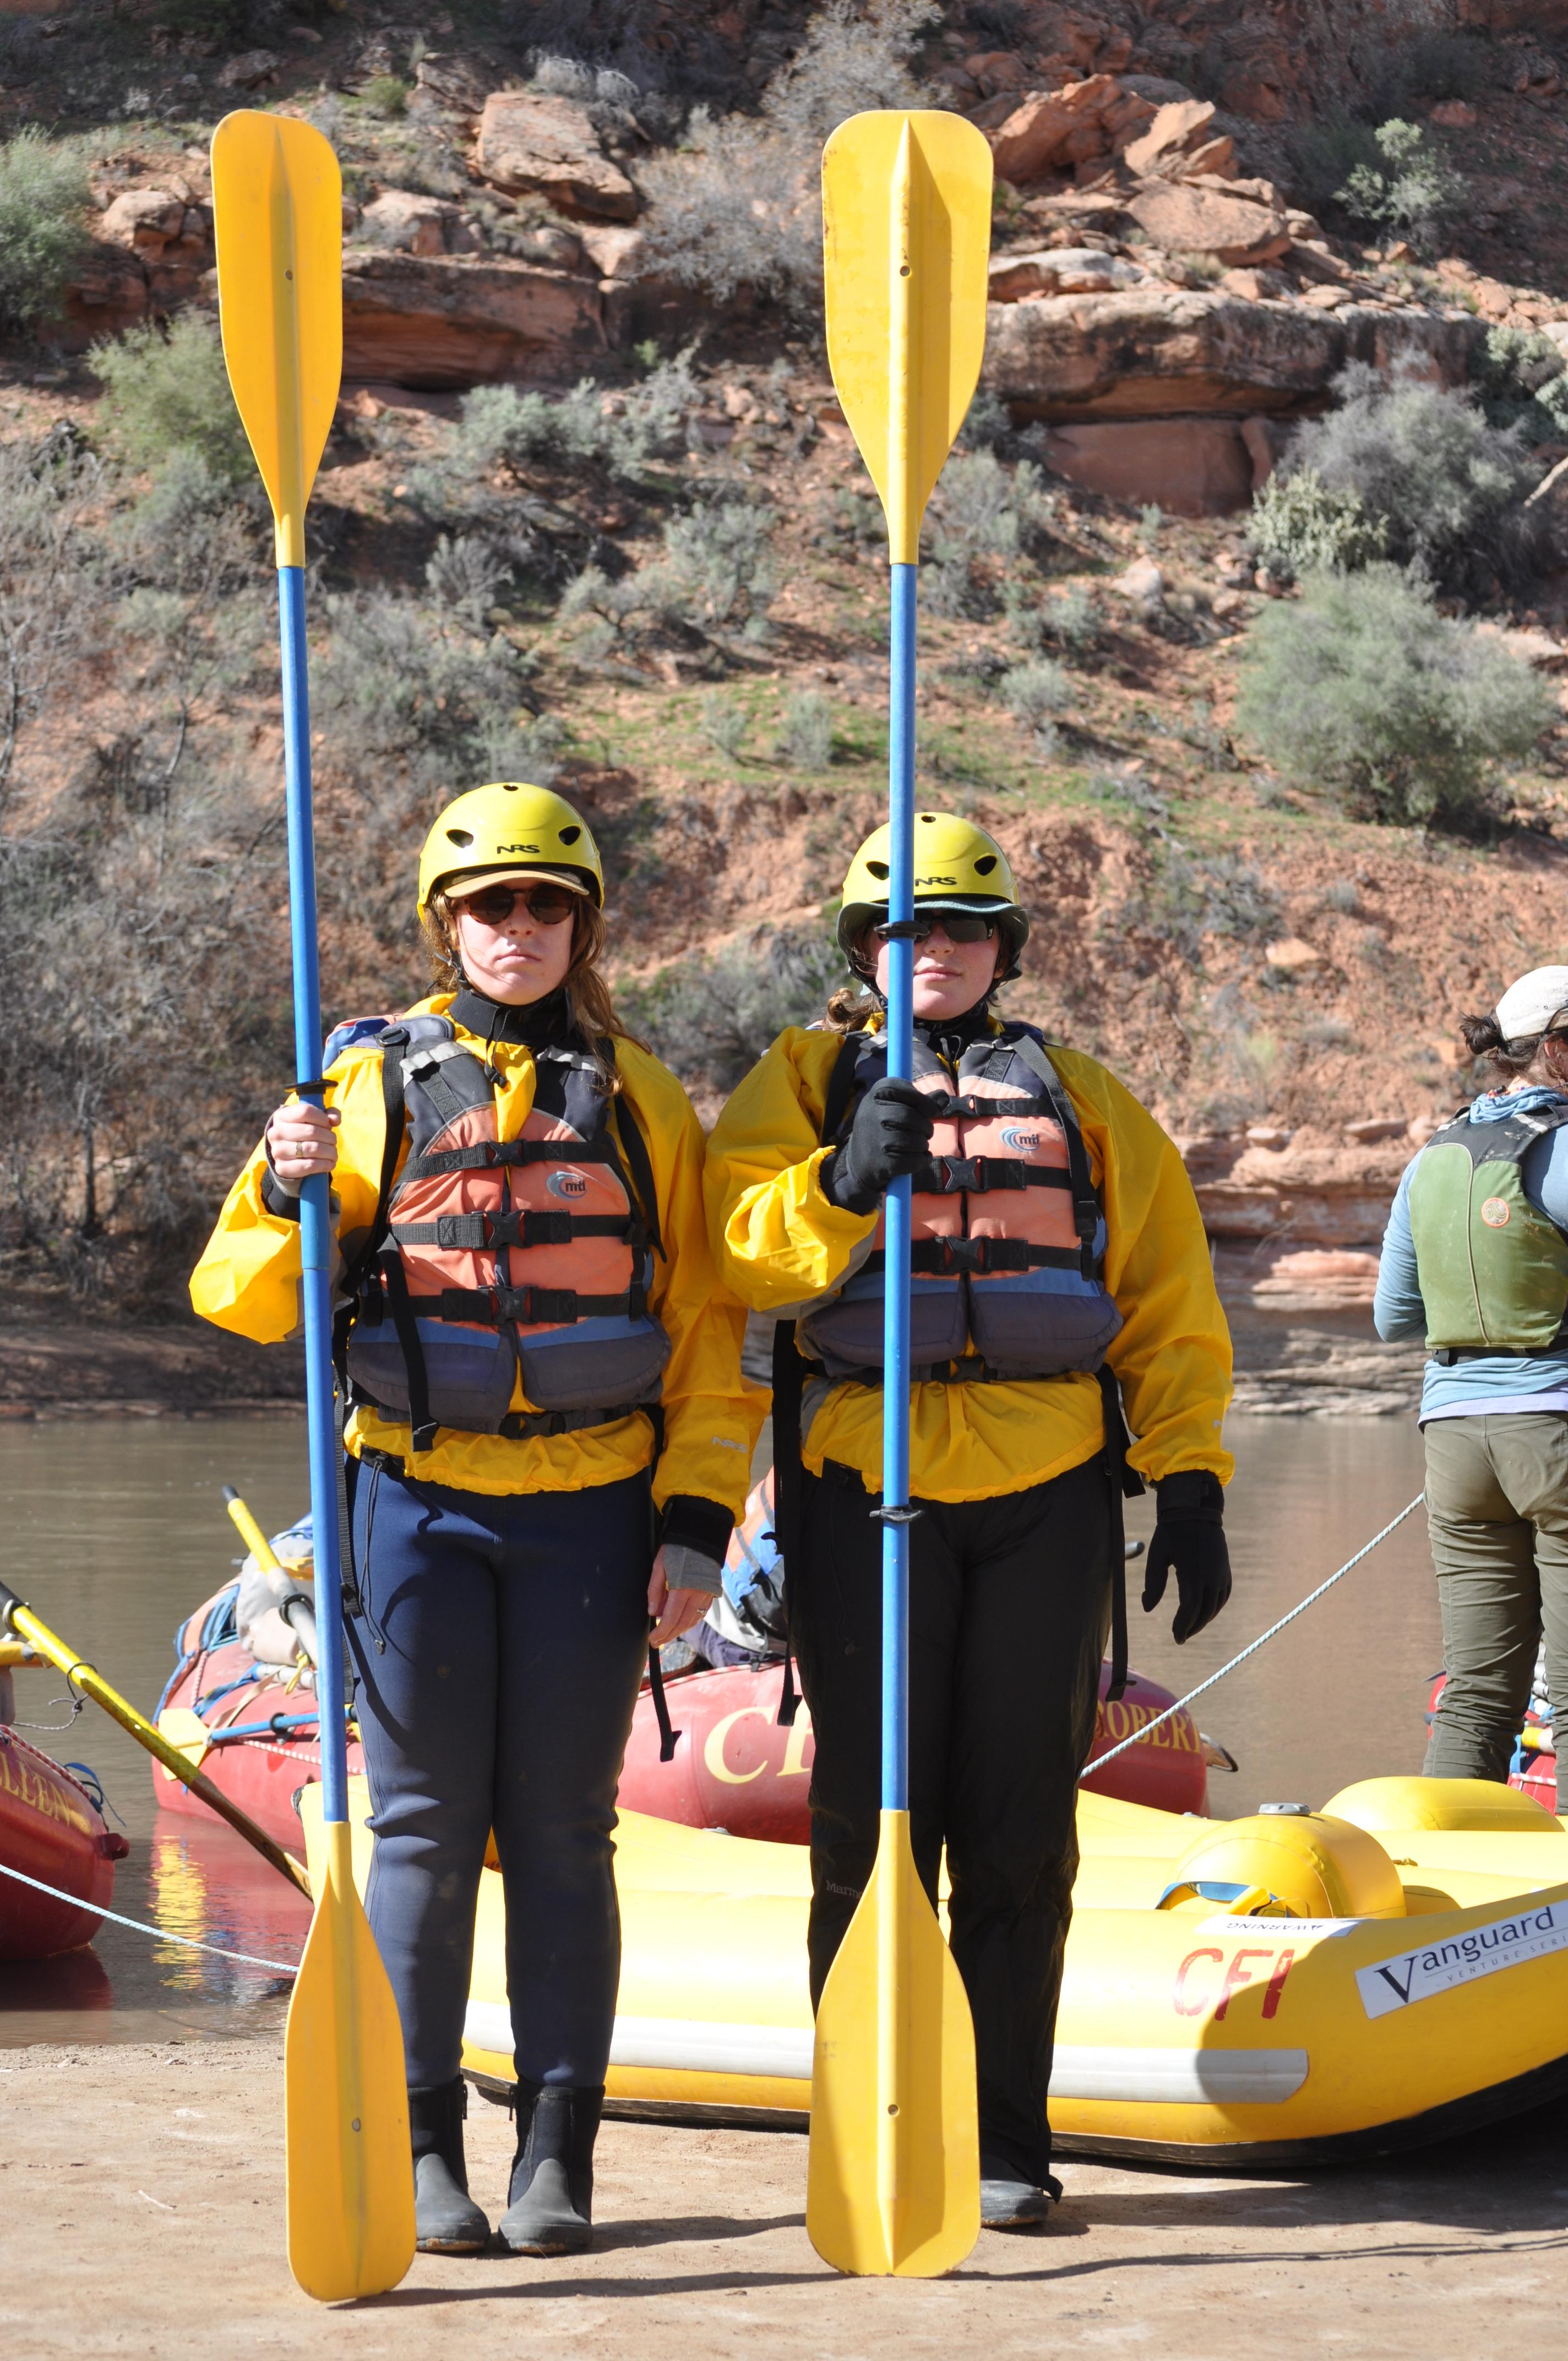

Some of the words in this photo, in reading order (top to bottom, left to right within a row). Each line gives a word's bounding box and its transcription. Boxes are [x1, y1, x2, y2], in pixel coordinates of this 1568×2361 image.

[497, 845, 541, 854] NRS
[914, 877, 957, 886] NRS
[711, 1435, 747, 1453] NRS
[0, 1751, 70, 1827] LLEN
[1374, 1906, 1554, 2004] Vanguard
[1447, 1951, 1520, 1982] VENTURE
[1529, 1935, 1566, 1952] SERI
[1173, 1947, 1295, 2021] CFI
